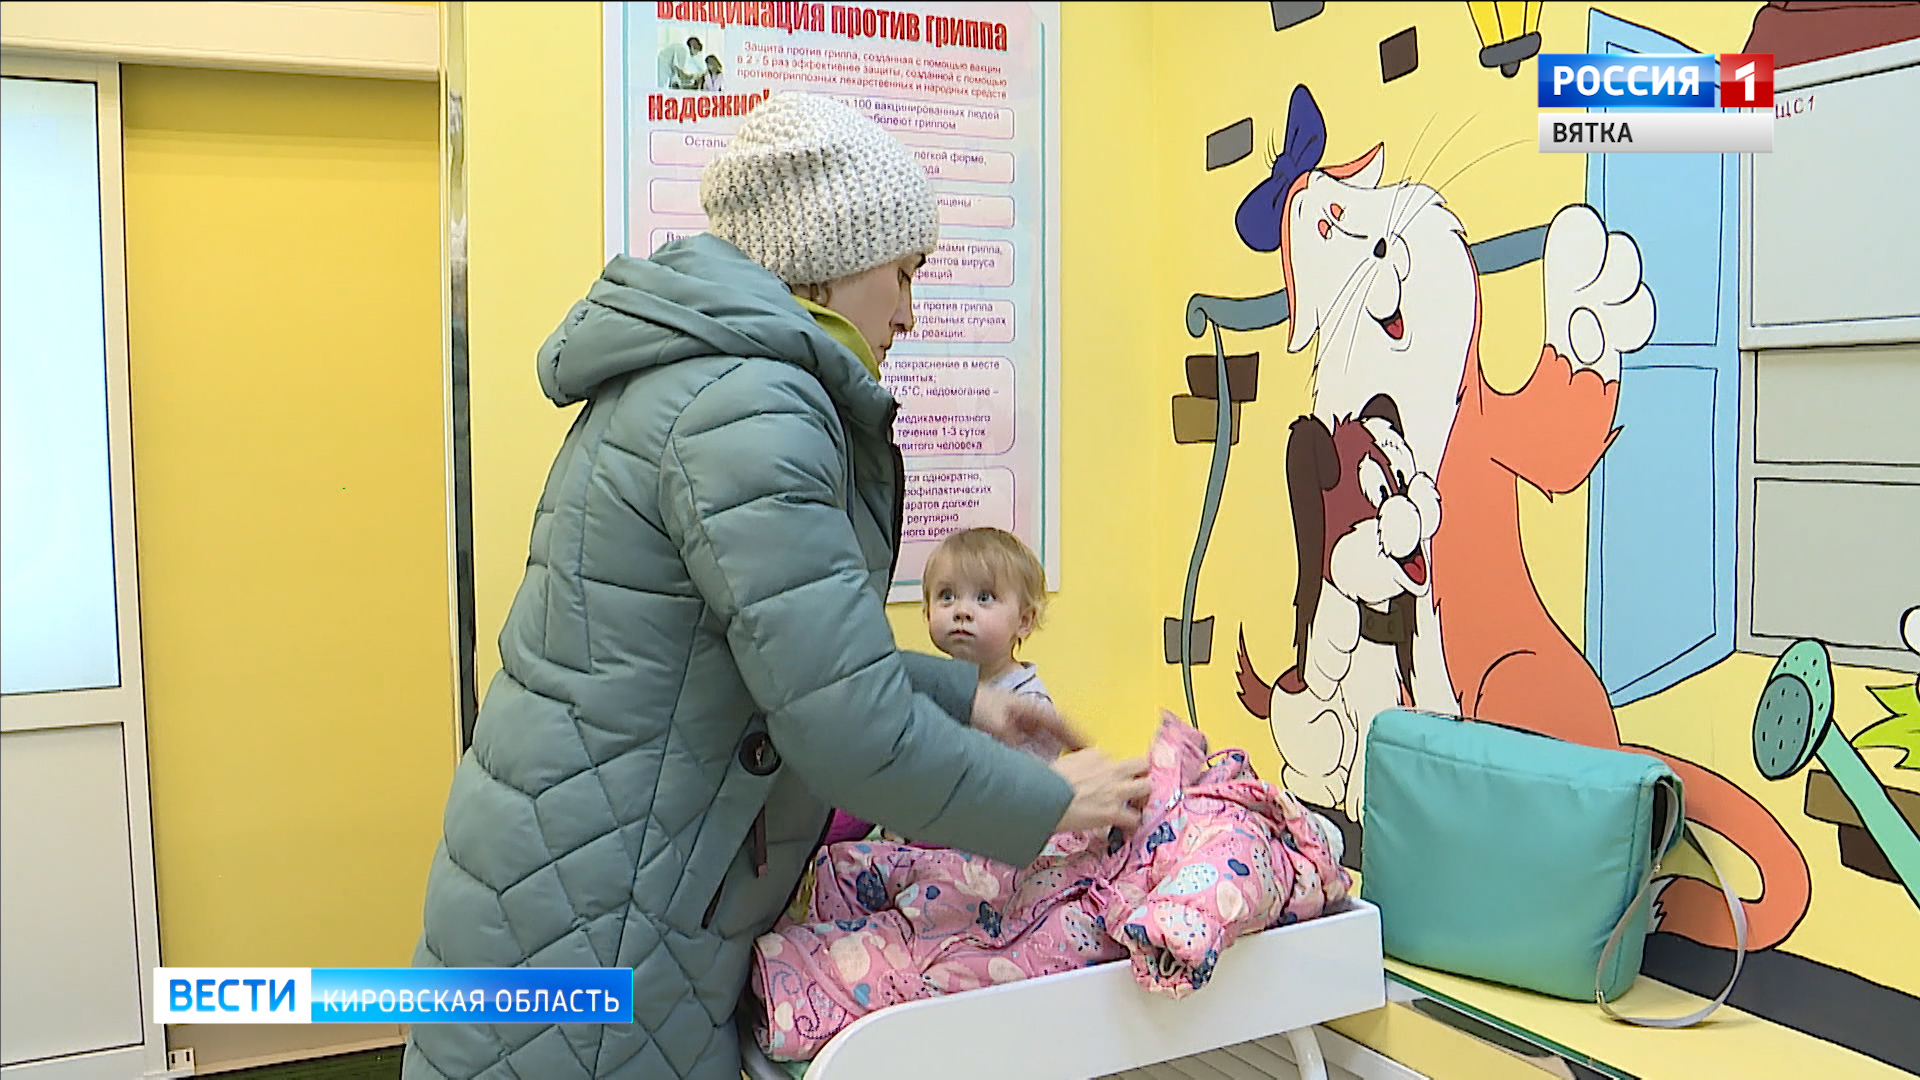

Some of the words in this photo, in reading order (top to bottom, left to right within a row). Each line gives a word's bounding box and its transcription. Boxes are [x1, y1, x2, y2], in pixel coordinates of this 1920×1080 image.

[657, 2, 825, 35] Вакцинация
[831, 5, 920, 42] против
[926, 15, 1008, 51] гриппа
[744, 41, 784, 54] Защита
[787, 45, 821, 58] против
[824, 49, 860, 61] гриппа,
[863, 53, 913, 66] созданная
[923, 60, 968, 71] помощью
[970, 64, 1001, 74] вакцин
[771, 58, 789, 68] раз
[792, 60, 861, 74] эффективнее
[863, 65, 903, 77] защиты,
[905, 69, 954, 81] созданной
[964, 76, 1007, 88] помощью
[737, 68, 837, 85] противогриппозных
[839, 76, 913, 90] лекарственных
[924, 84, 968, 97] народных
[971, 88, 1007, 100] средств
[854, 100, 872, 110] 100
[875, 102, 964, 118] вакцинированных
[967, 108, 1000, 120] людей
[915, 118, 956, 130] гриппом
[684, 135, 729, 148] Осталь
[950, 153, 986, 165] форме,
[937, 198, 972, 208] ищены
[967, 245, 1002, 255] гриппа,
[962, 259, 995, 269] вируса
[914, 269, 953, 280] фекций
[923, 302, 958, 312] против
[960, 303, 993, 313] гриппа
[967, 317, 1006, 328] случаях
[922, 329, 966, 341] реакции.
[895, 360, 960, 371] покраснение
[971, 361, 1000, 369] месте
[926, 386, 991, 398] недомогание
[897, 415, 991, 424] медикаментозного
[898, 429, 938, 438] течение
[942, 427, 957, 437] 1-3
[959, 429, 986, 439] суток
[936, 442, 982, 451] человека
[922, 473, 982, 483] однократно,
[904, 501, 939, 511] аратов
[942, 499, 980, 510] должен
[907, 513, 959, 525] регулярно
